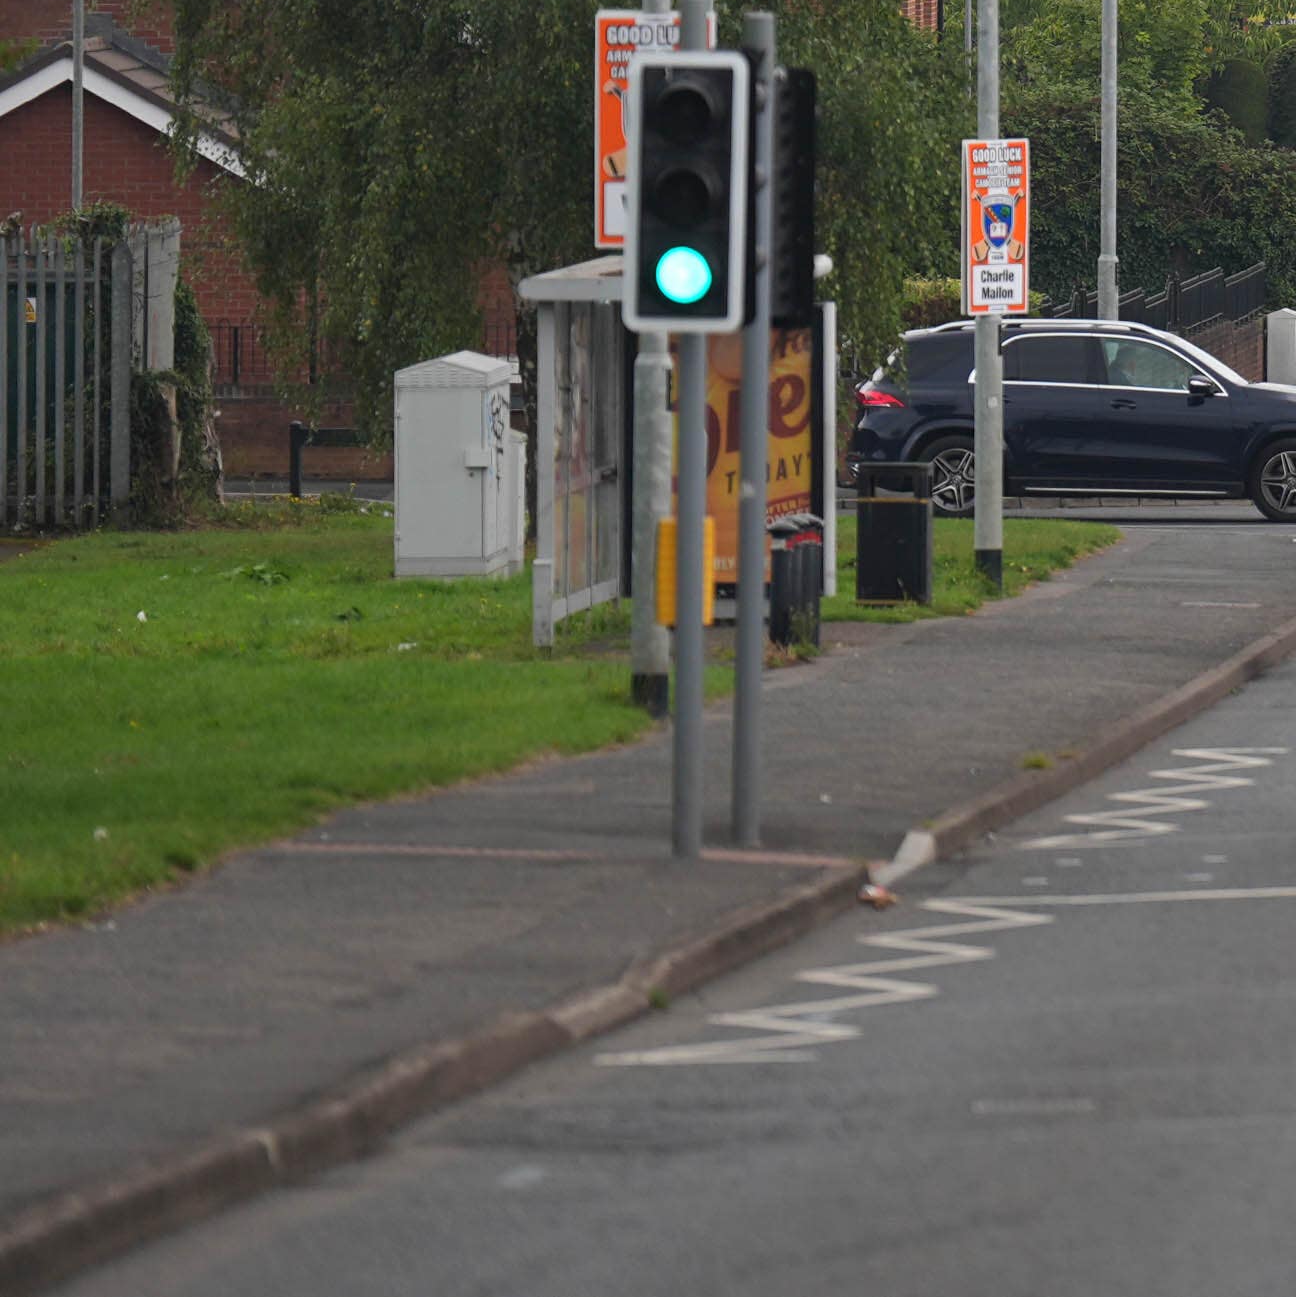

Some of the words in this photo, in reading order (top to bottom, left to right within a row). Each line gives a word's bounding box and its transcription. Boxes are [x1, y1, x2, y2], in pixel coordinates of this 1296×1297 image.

[605, 24, 653, 46] GOOD
[972, 147, 997, 163] GOOD
[998, 147, 1022, 163] LUCK
[980, 269, 1014, 282] Charlie
[982, 286, 1014, 300] Mallon
